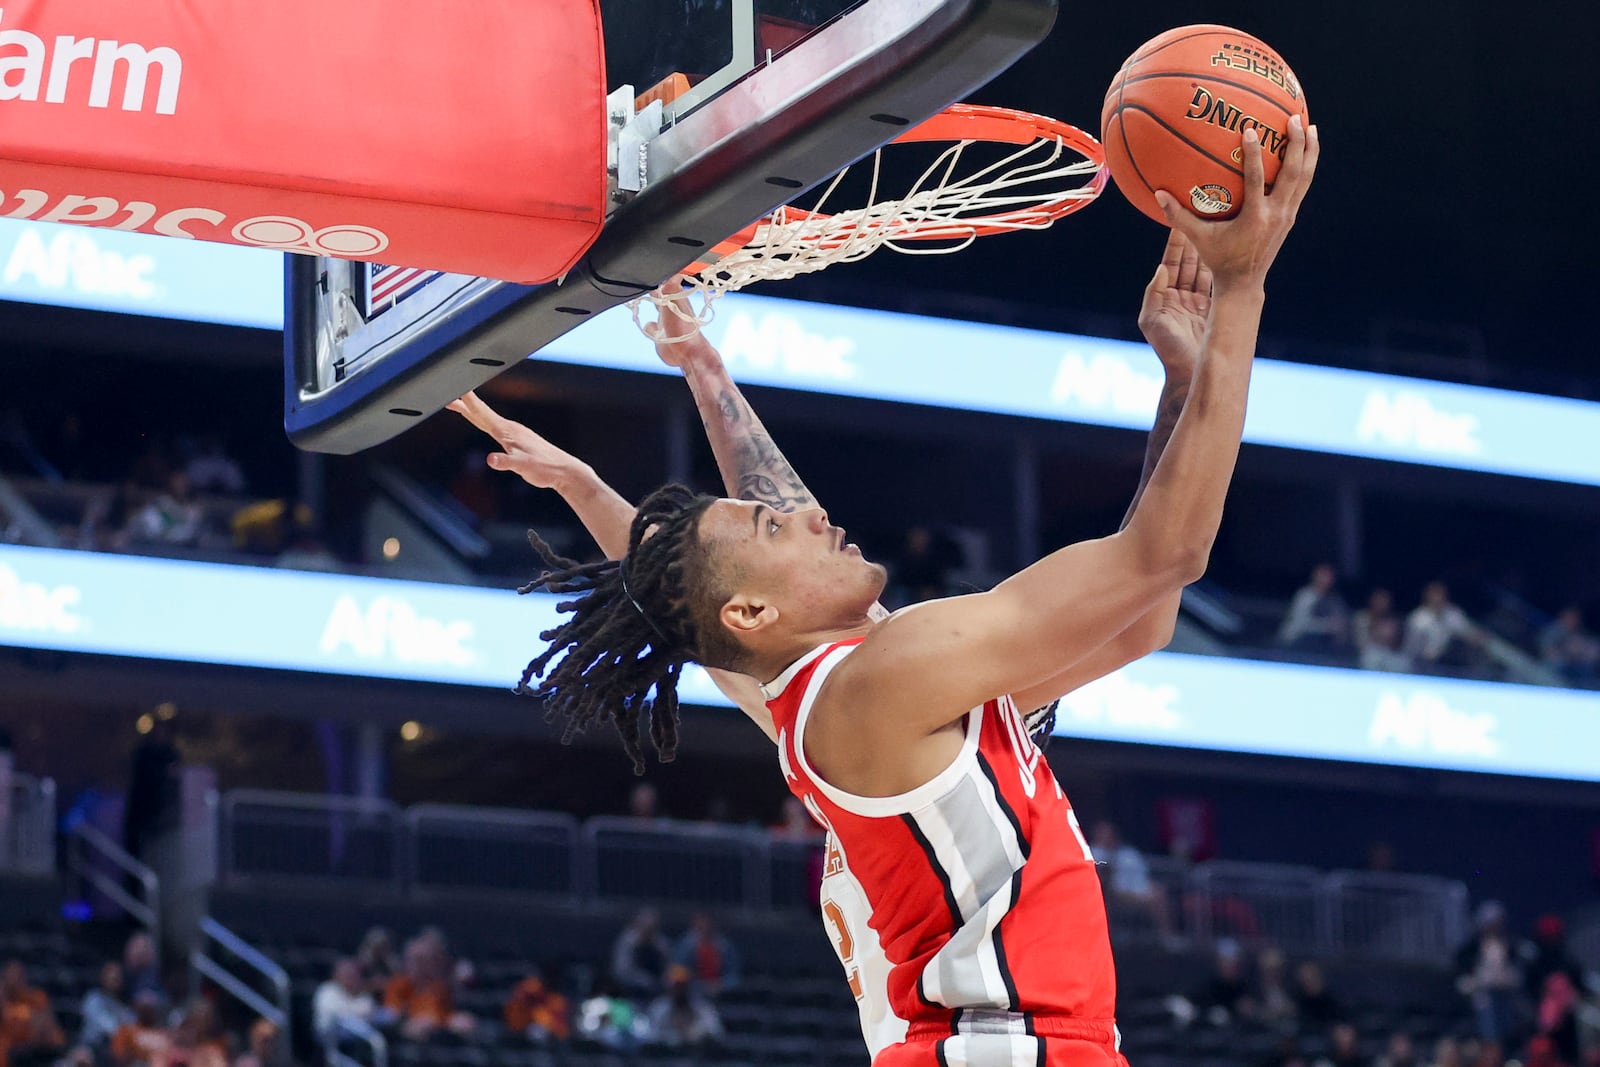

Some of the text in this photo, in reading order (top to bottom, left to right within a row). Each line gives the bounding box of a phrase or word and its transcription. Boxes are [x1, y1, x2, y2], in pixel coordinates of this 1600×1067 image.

[0, 28, 183, 115] arm
[1211, 50, 1297, 101] EGACY
[1185, 86, 1290, 161] ALDING
[0, 188, 227, 241] Stat
